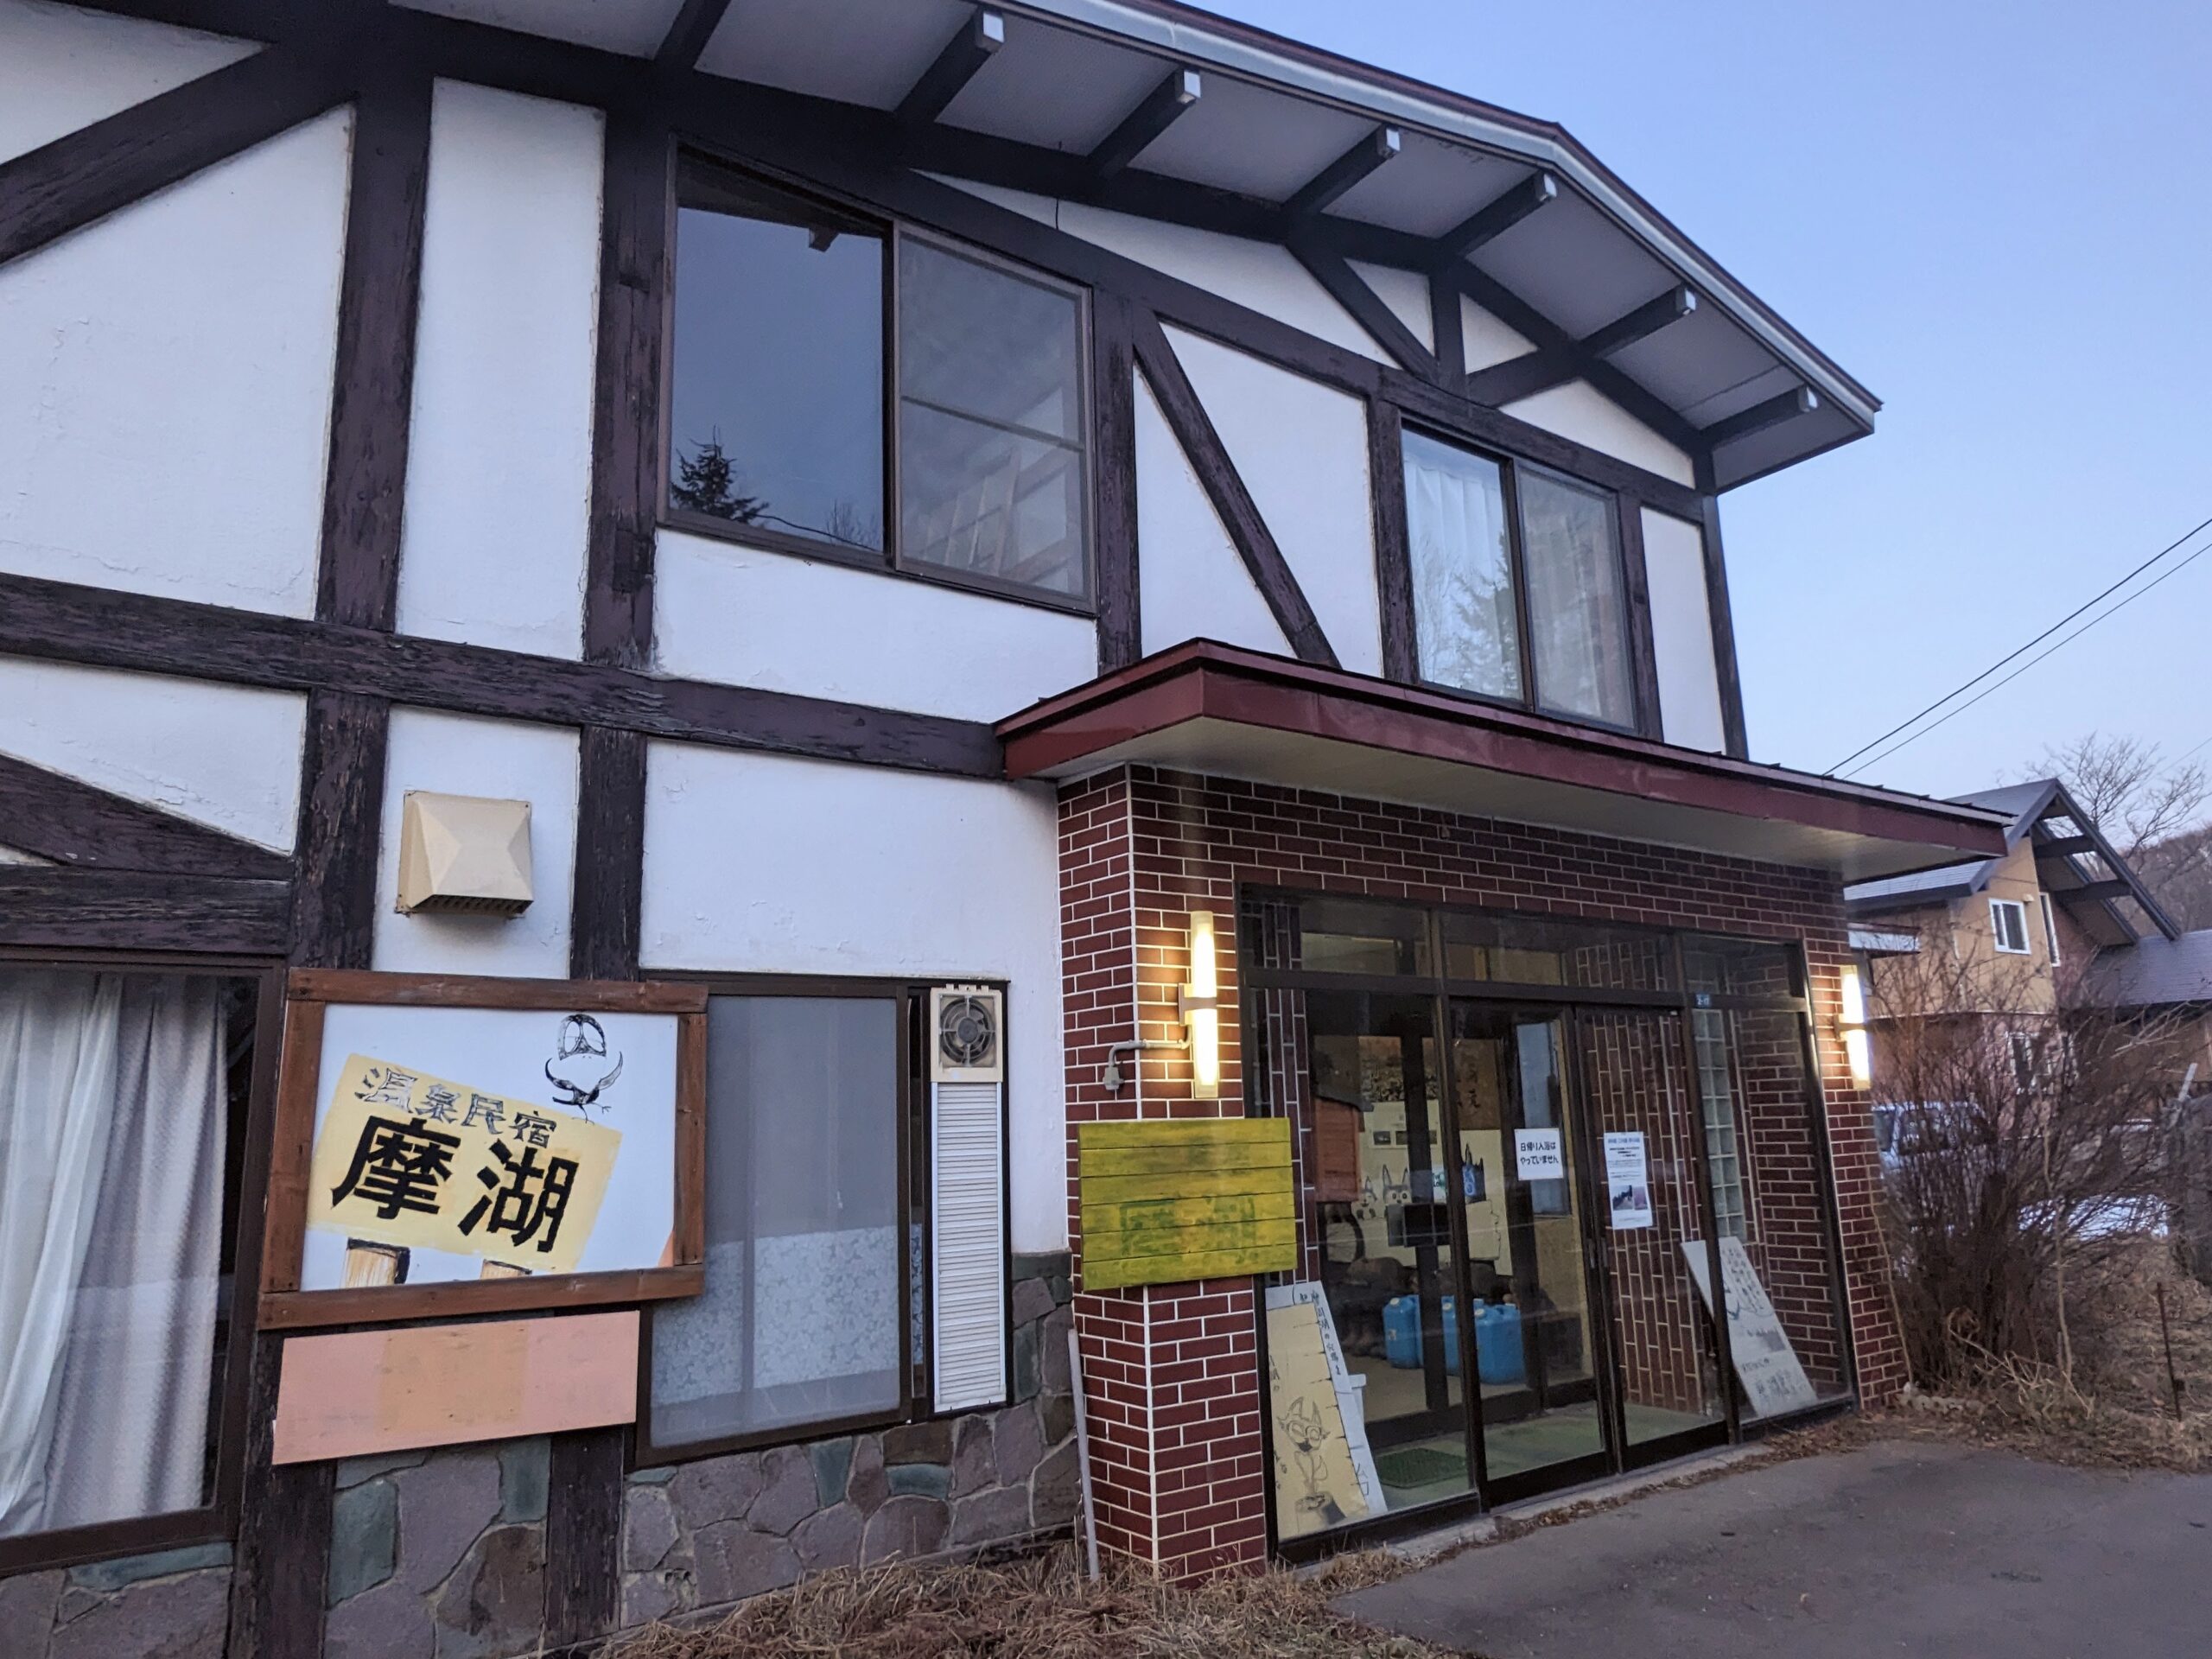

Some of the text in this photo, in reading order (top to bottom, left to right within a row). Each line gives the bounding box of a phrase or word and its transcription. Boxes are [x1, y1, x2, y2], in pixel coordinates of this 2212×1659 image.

[354, 1066, 557, 1148] 温泉民宿
[1520, 1141, 1556, 1152] 日帰り入浴は
[1520, 1154, 1559, 1166] やっていません
[330, 1116, 580, 1254] 摩湖
